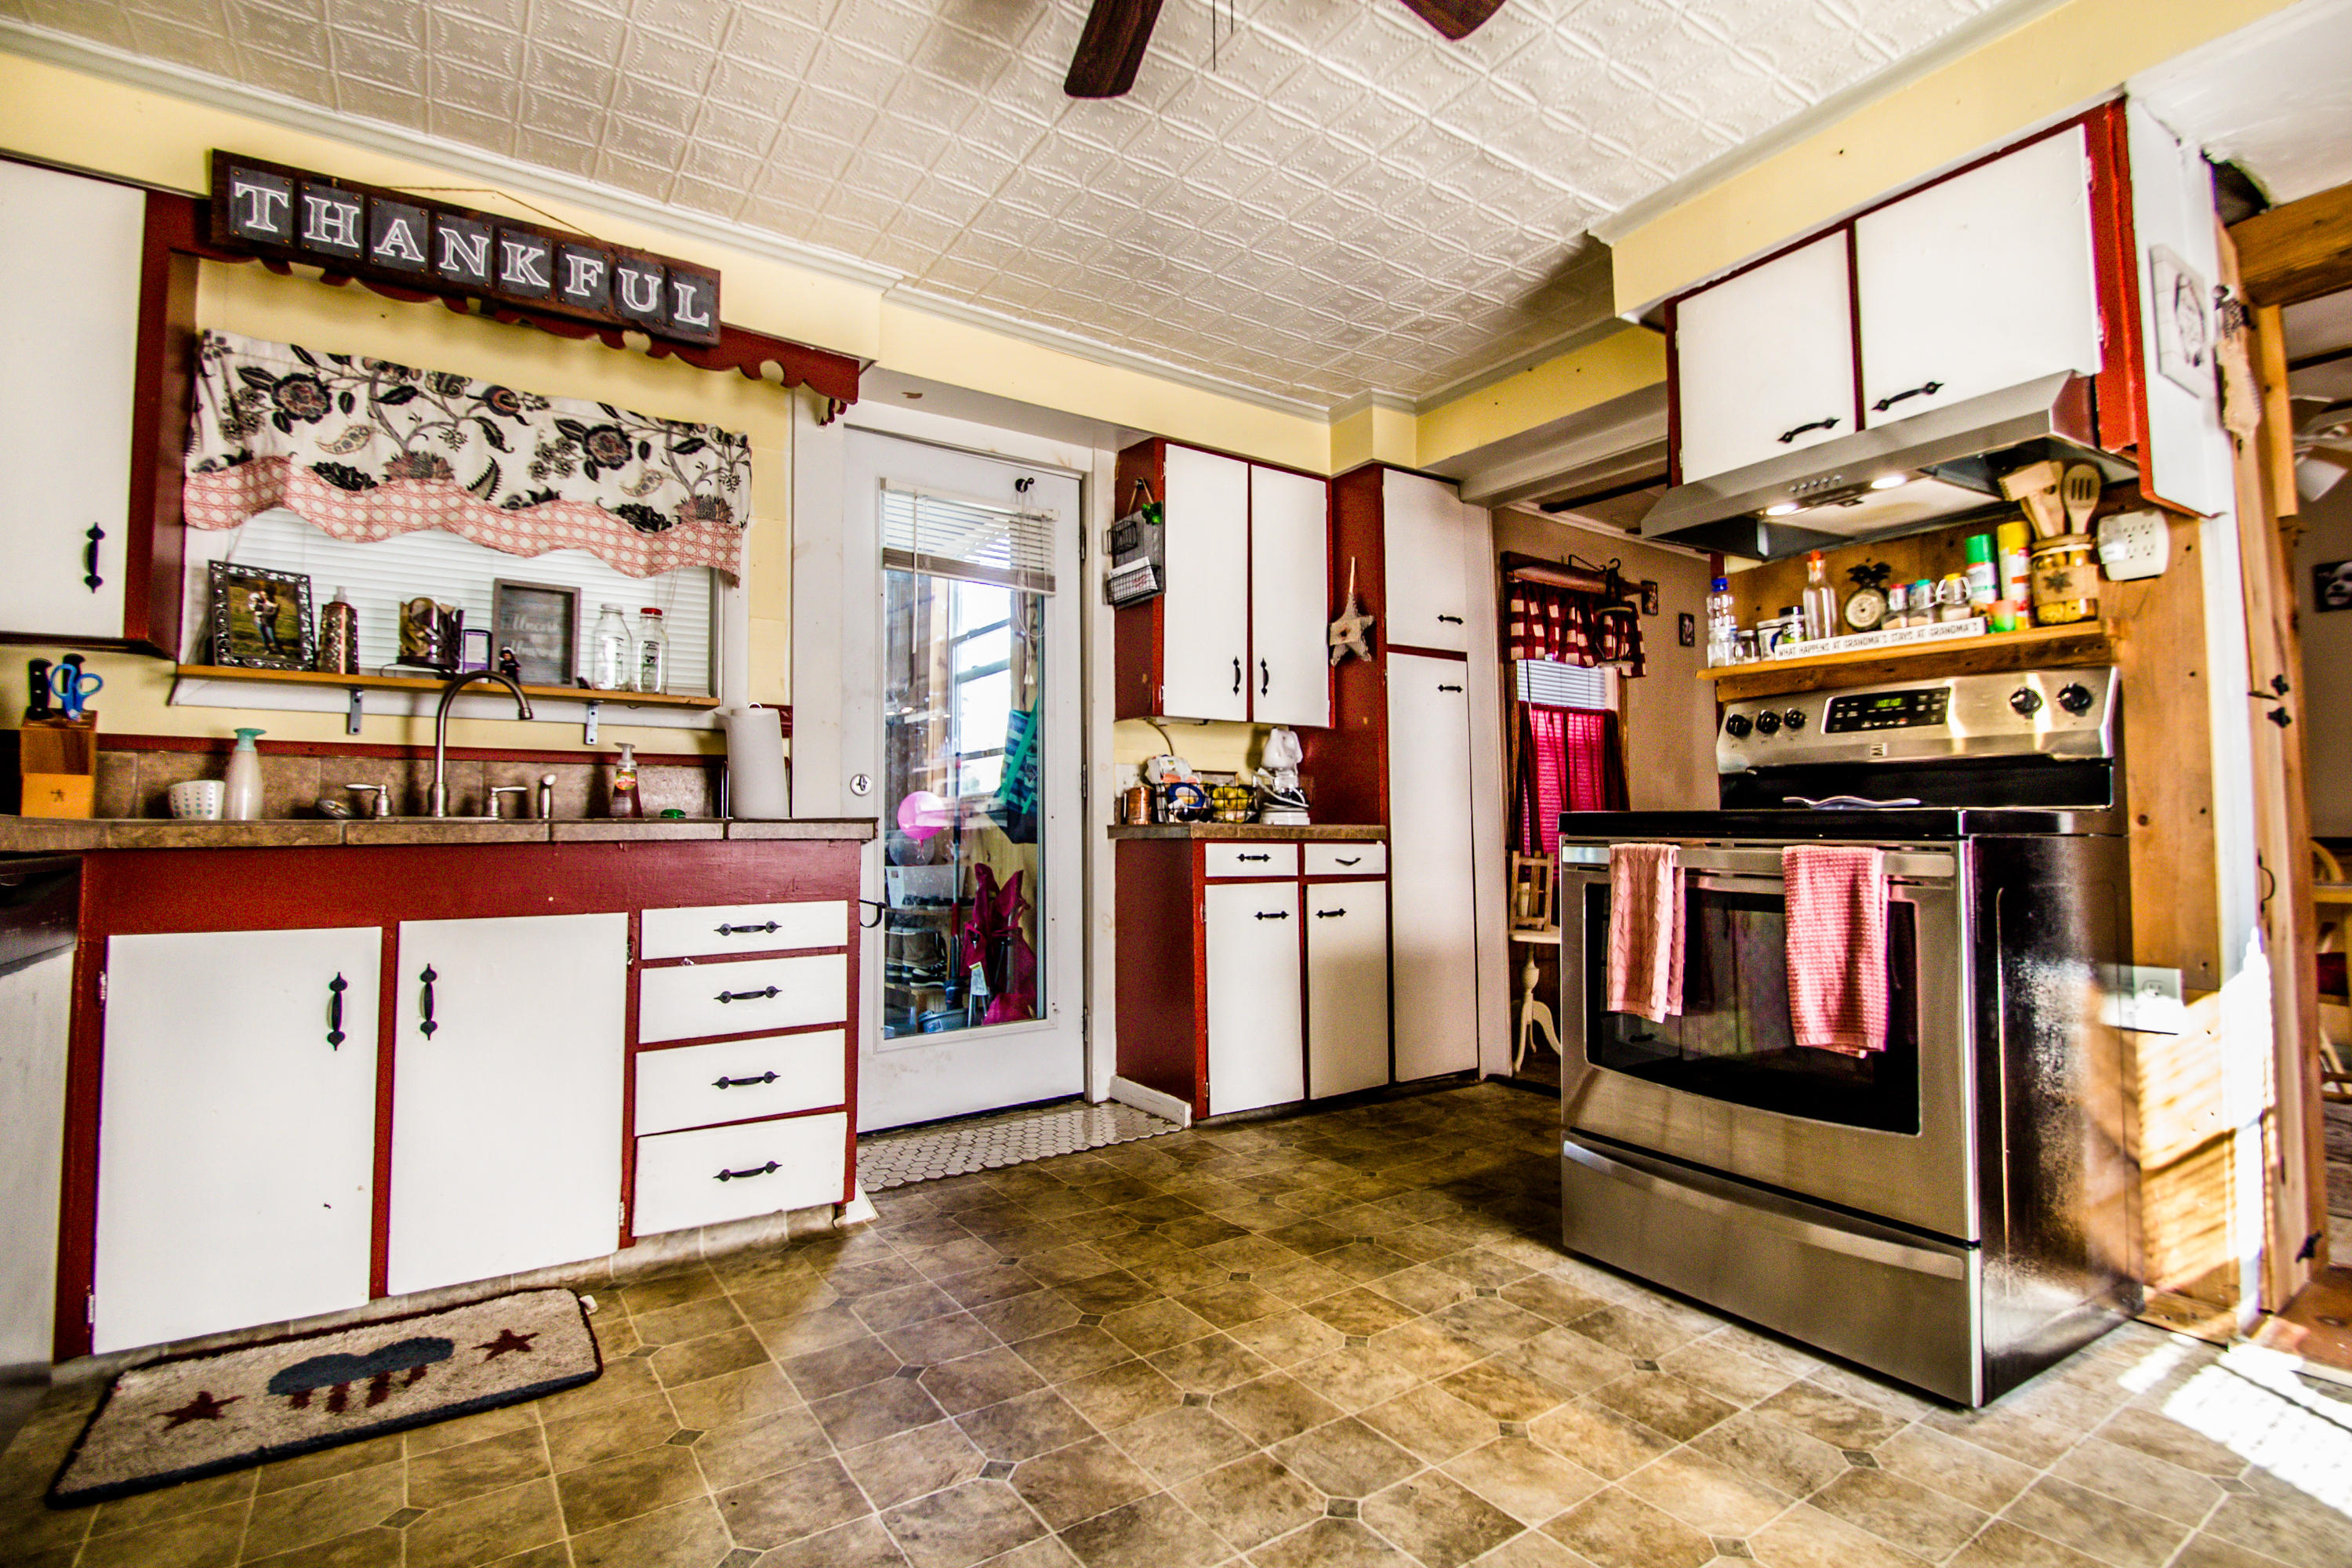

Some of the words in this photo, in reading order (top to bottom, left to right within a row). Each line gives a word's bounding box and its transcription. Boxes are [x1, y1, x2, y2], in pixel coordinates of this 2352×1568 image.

[234, 181, 710, 327] THANKFUL
[1778, 647, 1796, 657] WHAT
[1799, 642, 1830, 654] HAPPENS
[1833, 640, 1841, 650] AT
[1844, 634, 1887, 649] GRANDMA'S
[1890, 630, 1913, 642] STAYS
[1918, 628, 1926, 638] AT
[1930, 622, 1978, 637] GRANDMA'S
